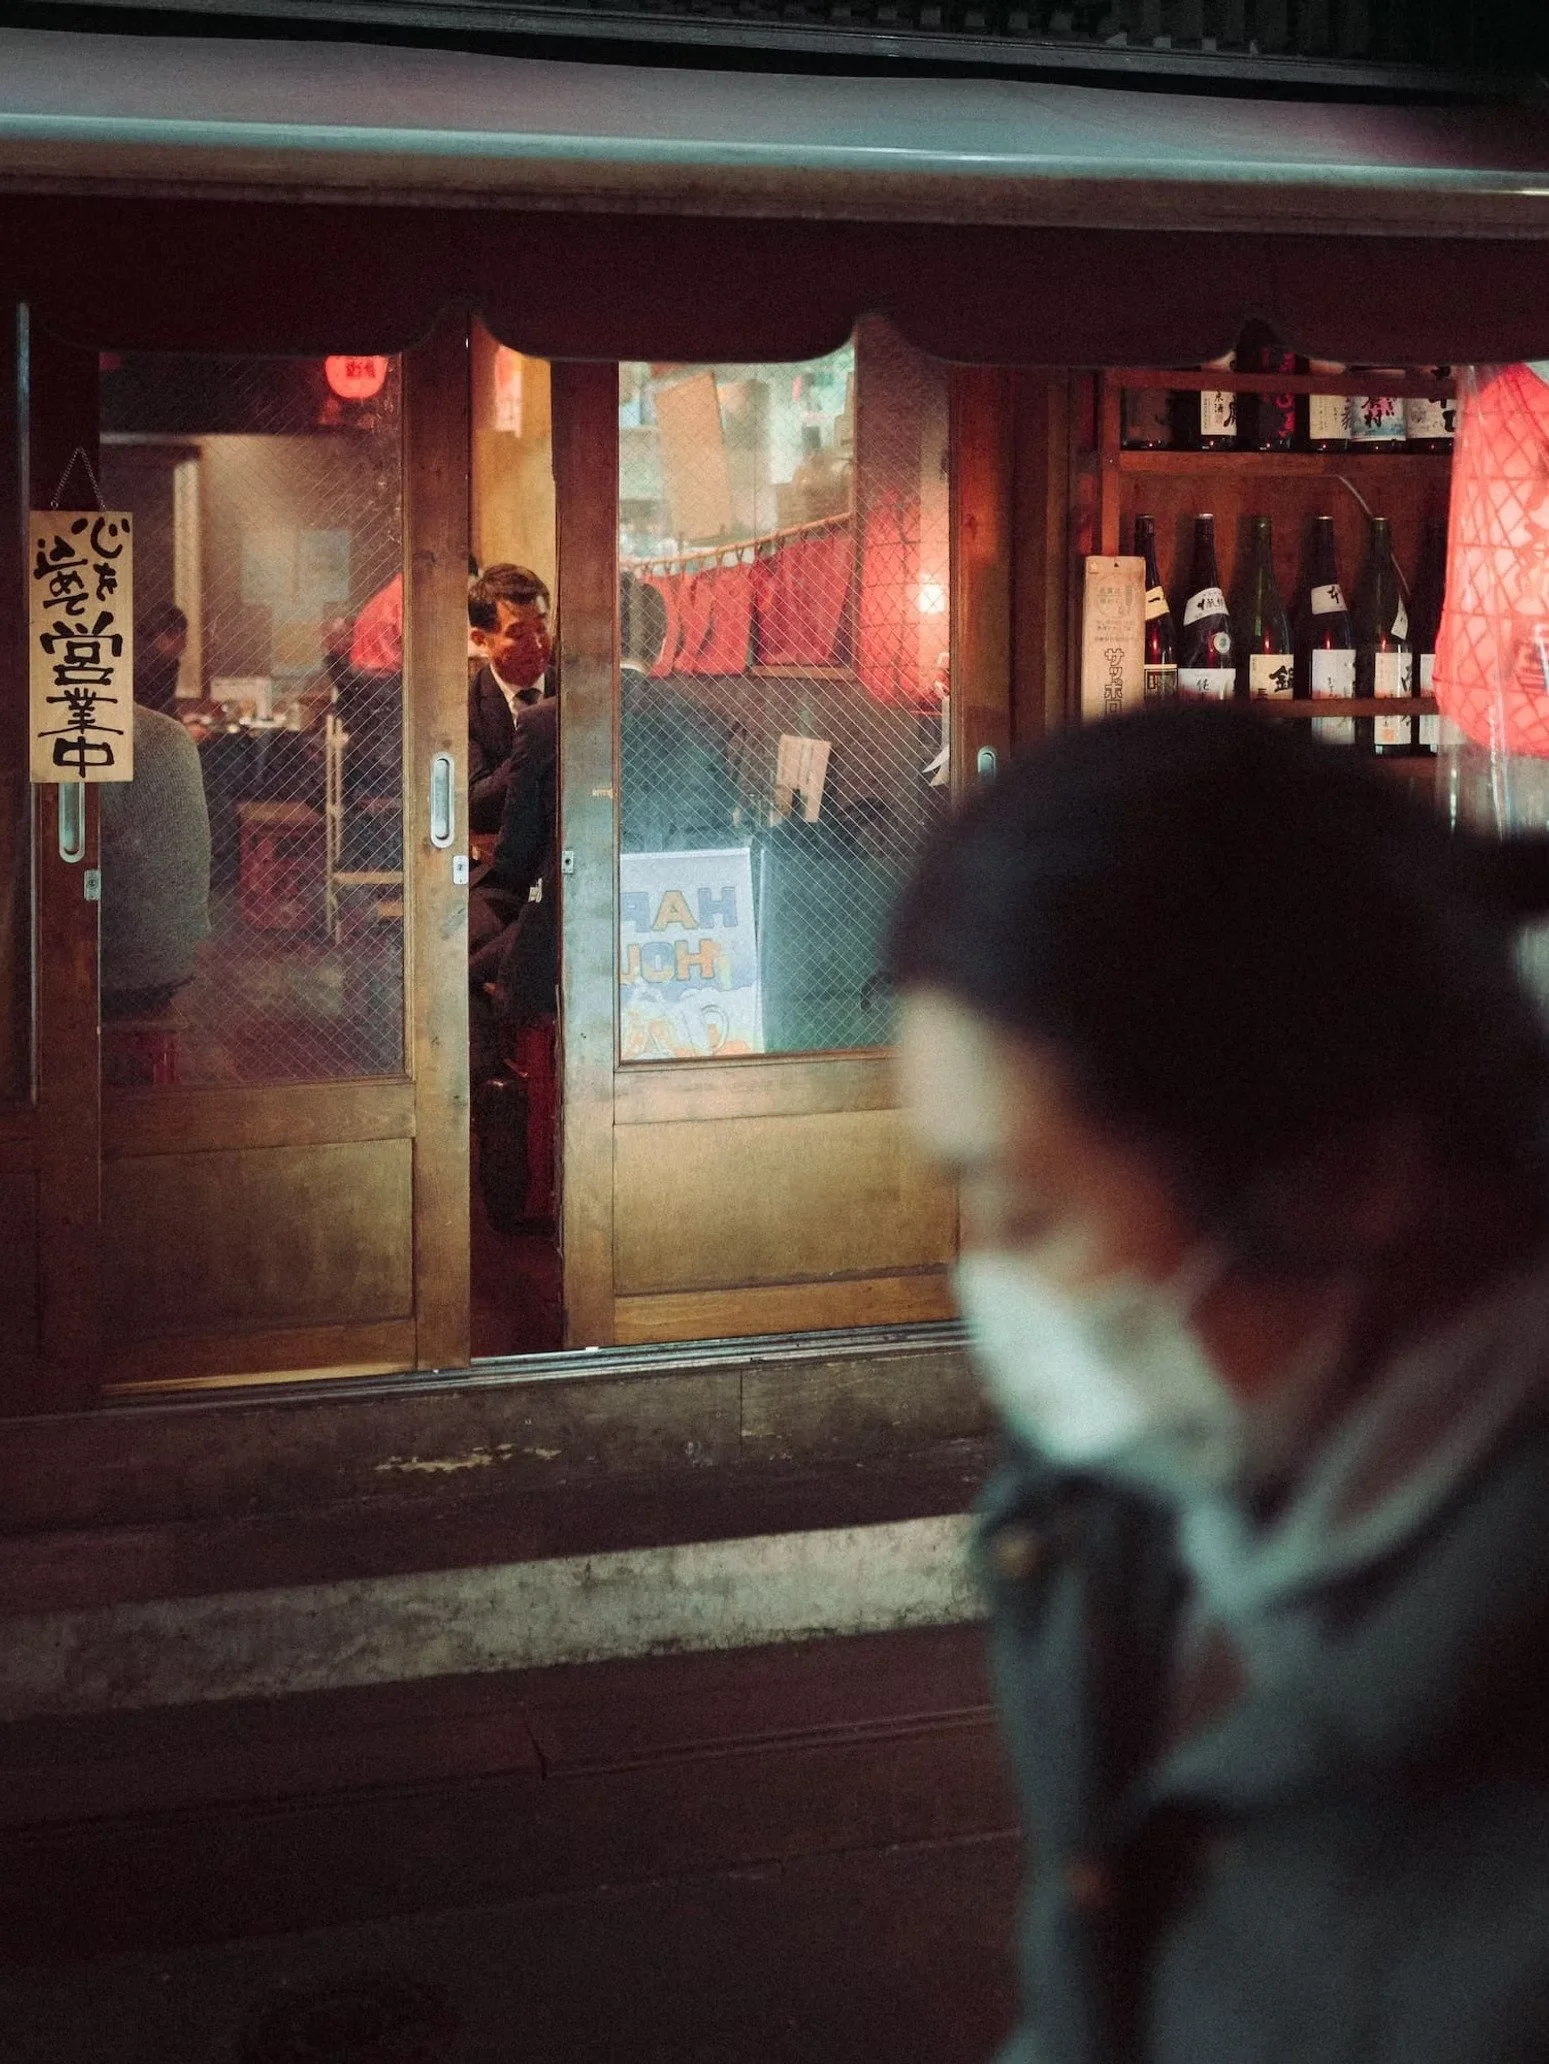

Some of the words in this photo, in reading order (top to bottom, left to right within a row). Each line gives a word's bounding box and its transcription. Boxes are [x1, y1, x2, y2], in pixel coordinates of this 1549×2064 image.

[33, 535, 89, 616] 込めて
[71, 516, 130, 601] 心を
[37, 611, 124, 778] 営業中
